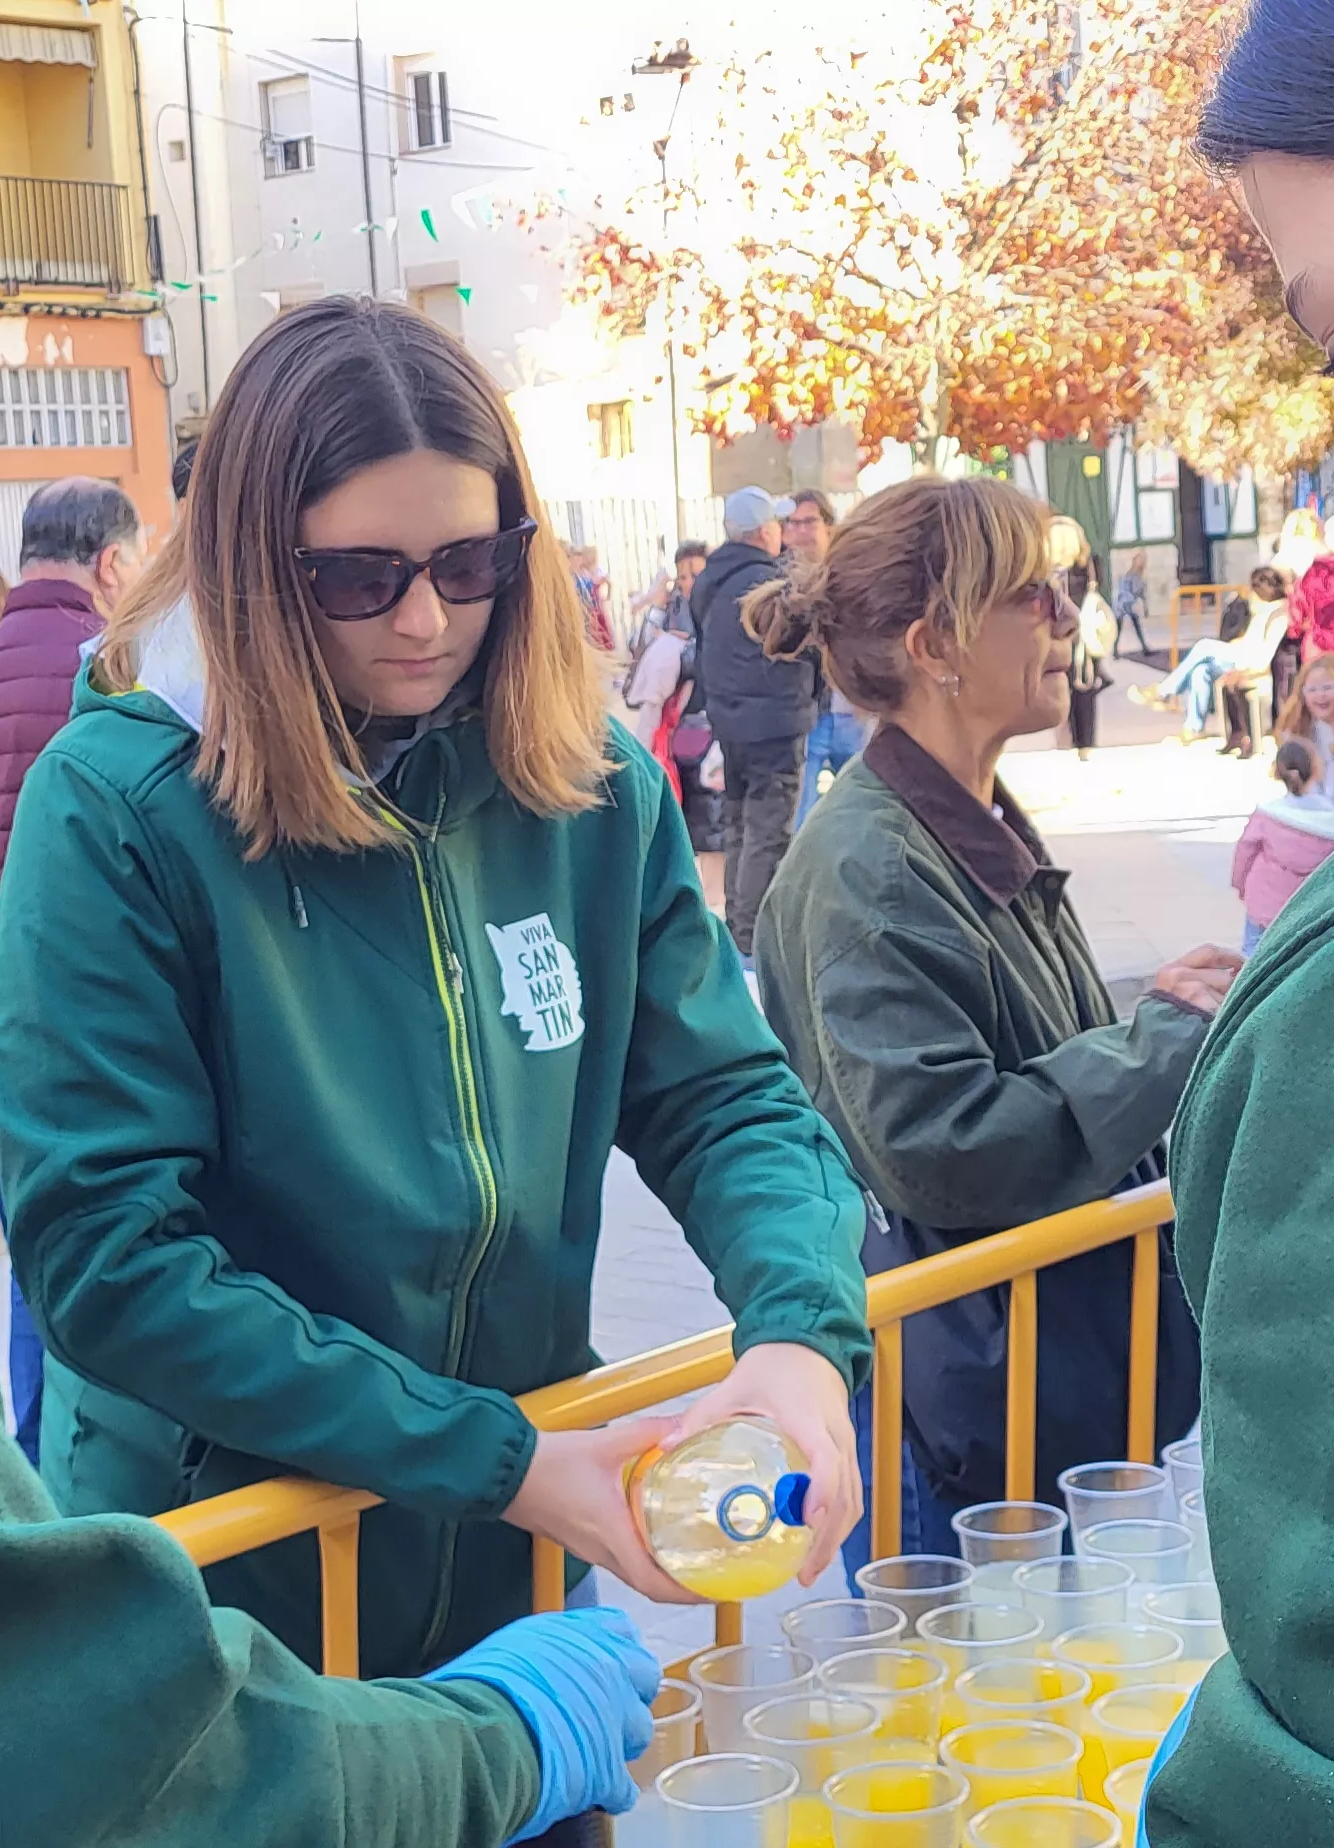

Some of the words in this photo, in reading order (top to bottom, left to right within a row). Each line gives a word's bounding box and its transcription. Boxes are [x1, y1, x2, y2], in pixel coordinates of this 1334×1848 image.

[520, 923, 552, 945] VIVA
[518, 943, 560, 979] SAN
[528, 975, 567, 1007] MAR
[536, 1000, 574, 1041] TIN
